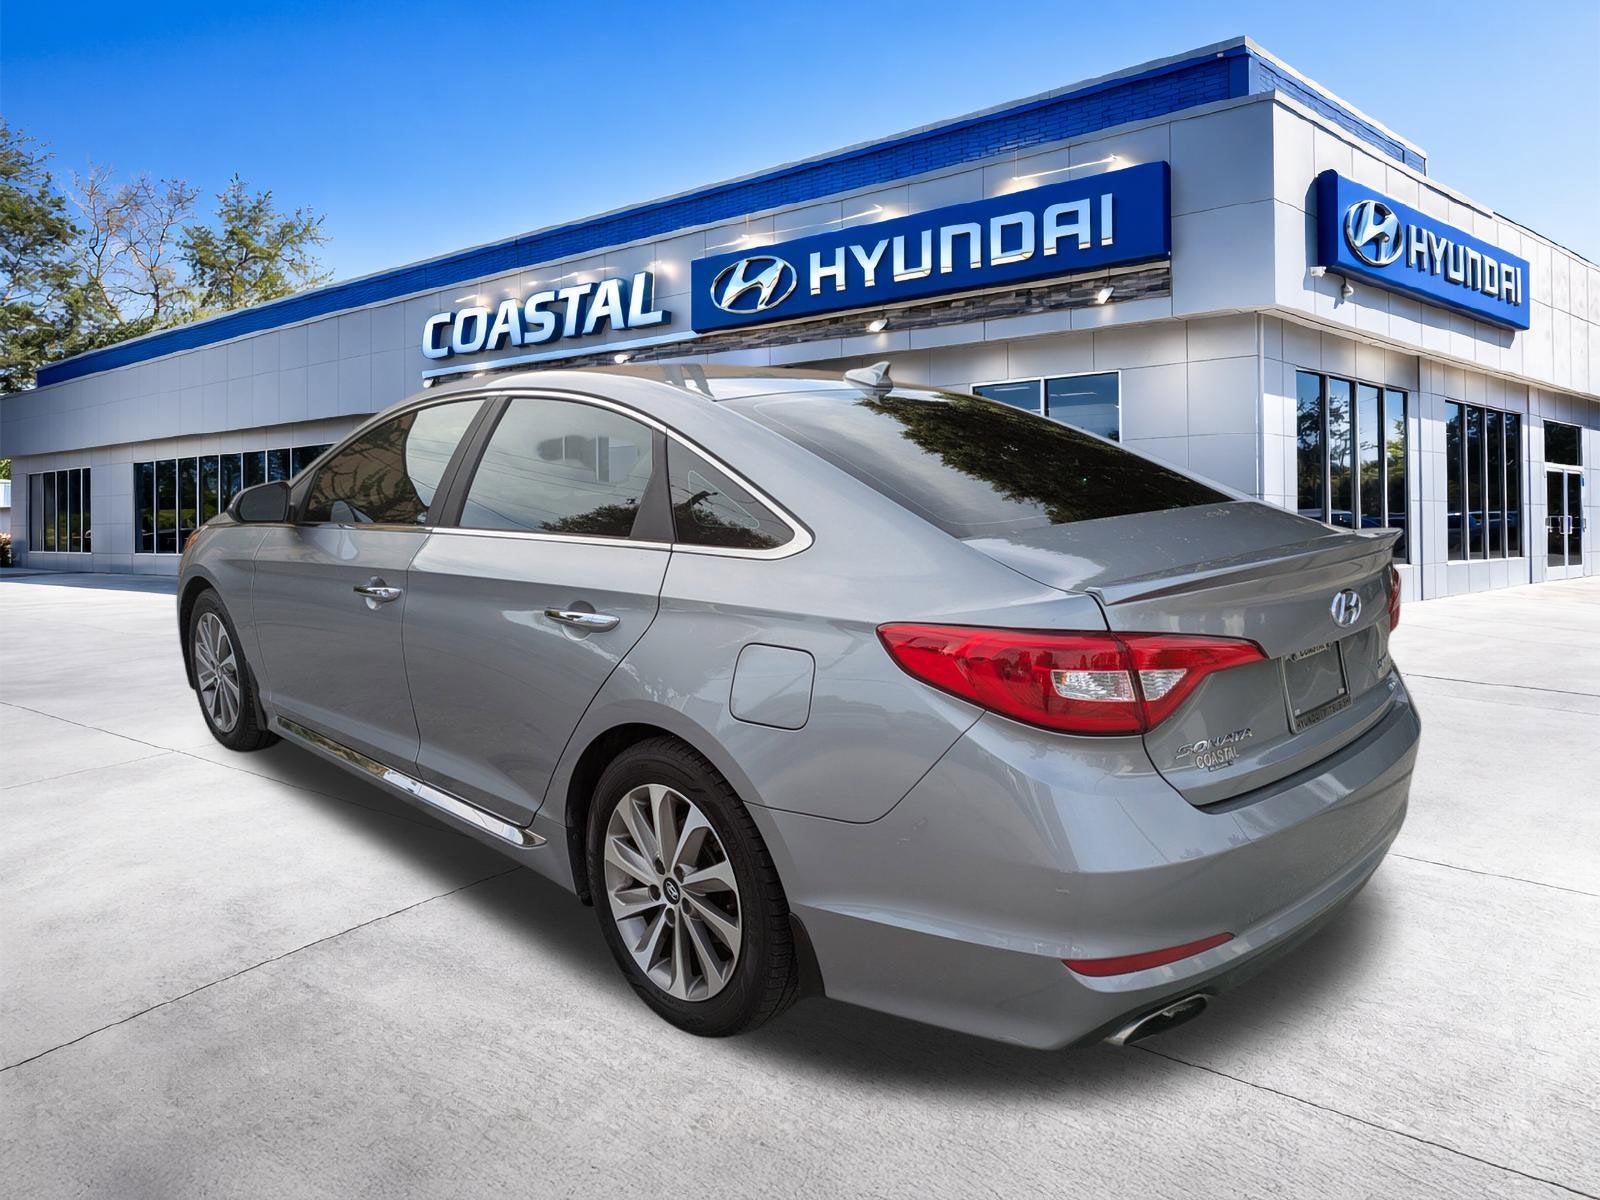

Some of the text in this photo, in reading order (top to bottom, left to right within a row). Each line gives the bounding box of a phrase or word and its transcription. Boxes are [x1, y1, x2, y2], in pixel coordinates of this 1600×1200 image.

[808, 192, 1114, 296] HYUNDAI
[1406, 224, 1522, 306] HYUNDAI
[421, 270, 671, 360] COASTAL
[1175, 728, 1253, 759] SONATA
[1195, 745, 1240, 769] COASTAL
